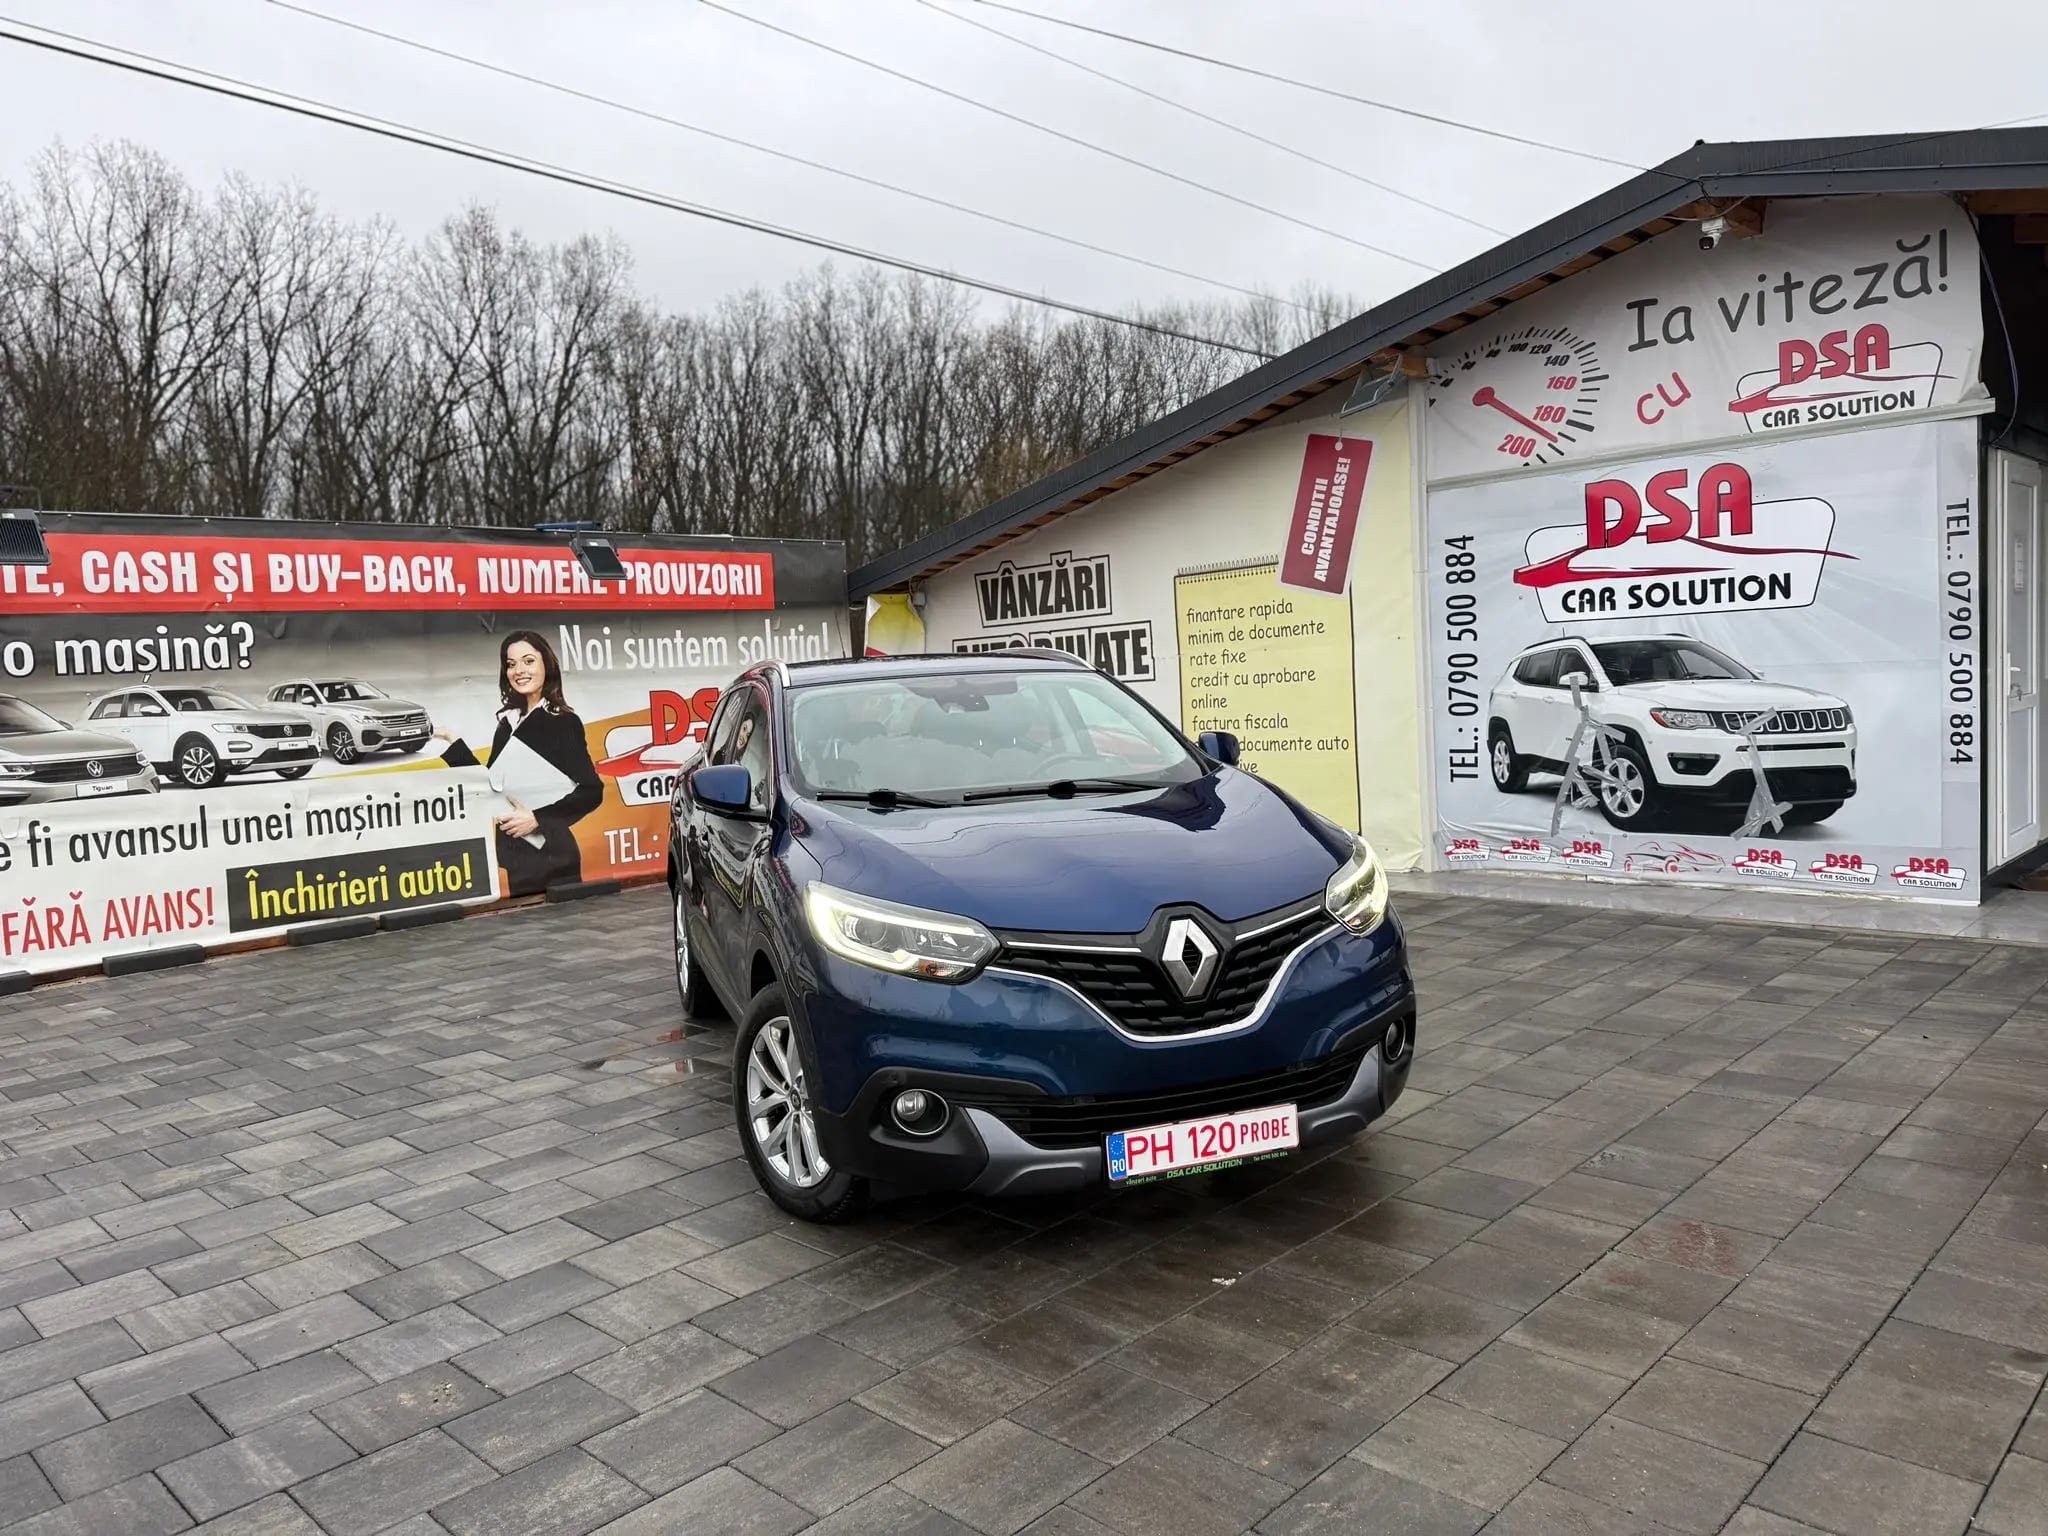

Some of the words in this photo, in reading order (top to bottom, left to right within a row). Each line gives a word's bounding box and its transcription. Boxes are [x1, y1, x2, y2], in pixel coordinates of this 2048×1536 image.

[1626, 298, 1695, 352] Ia
[1718, 228, 1948, 332] viteză!
[1529, 343, 1553, 355] 120
[1544, 354, 1570, 367] 140
[1778, 323, 1890, 386] DSA
[1546, 375, 1577, 390] 160
[1637, 371, 1692, 425] cu
[1532, 405, 1566, 424] 180
[1762, 404, 1800, 428] CAR
[1807, 389, 1915, 423] SOLUTION
[1497, 433, 1536, 458] 200
[1313, 457, 1351, 582] AVANTAJOASE!
[1585, 462, 1753, 550] DSA
[1946, 498, 1970, 560] TEL.:
[81, 550, 198, 593] CASH
[212, 551, 254, 603] ȘI
[267, 553, 467, 596] BUY-BACK,
[619, 561, 762, 595] PROVIZORII
[1445, 534, 1476, 585] 884
[980, 558, 1107, 621] VÂNZĂRI
[1561, 586, 1616, 613] CAR
[1628, 573, 1791, 608] SOLUTION
[1947, 570, 1972, 641] 0790
[1186, 605, 1246, 625] finantare
[1249, 598, 1293, 620] rapida
[1447, 593, 1478, 642] 500
[3, 641, 35, 677] o
[55, 620, 255, 683] mașină?
[559, 624, 613, 671] Noi
[623, 629, 728, 669] suntem
[1188, 629, 1224, 646] minim
[1228, 626, 1244, 641] de
[1249, 620, 1325, 640] documente
[1189, 652, 1217, 667] rate
[1221, 648, 1247, 666] fixe
[1190, 671, 1229, 688] credit
[1234, 673, 1249, 686] cu
[1252, 667, 1316, 688] aprobare
[1448, 653, 1479, 718] 0790
[1950, 652, 1973, 703] 500
[650, 688, 723, 746] DS
[1191, 694, 1228, 709] online
[1192, 715, 1241, 731] factura
[1244, 713, 1288, 730] fiscala
[1950, 713, 1973, 764] 884
[1239, 736, 1312, 751] documente
[1317, 736, 1349, 751] auto
[1449, 727, 1479, 783] TEL.:
[27, 820, 53, 868] fi
[69, 805, 208, 863] avansul
[222, 803, 293, 846] unei
[306, 792, 402, 841] mașini
[413, 784, 466, 824] noi!
[1511, 838, 1540, 851] DSA
[603, 827, 661, 865] TEL.:
[1572, 840, 1602, 855] DSA
[1747, 848, 1782, 865] DSA
[1825, 853, 1863, 870] DSA
[1909, 857, 1949, 874] DSA
[244, 865, 389, 921] Închirieri
[398, 852, 473, 899] auto!
[1755, 868, 1789, 878] SOLUTION
[1835, 875, 1870, 884] SOLUTION
[1903, 878, 1916, 886] CAR
[1918, 879, 1957, 889] SOLUTION
[2, 890, 92, 956] FĂRĂ
[103, 887, 215, 941] AVANS!
[1126, 1130, 1175, 1170] PH
[1188, 1121, 1236, 1159] 120
[1240, 1116, 1290, 1145] PROBE
[1112, 1158, 1126, 1174] RO
[1167, 1170, 1184, 1178] DSA
[1185, 1166, 1202, 1175] CAR
[1203, 1158, 1243, 1172] SOLUTION
